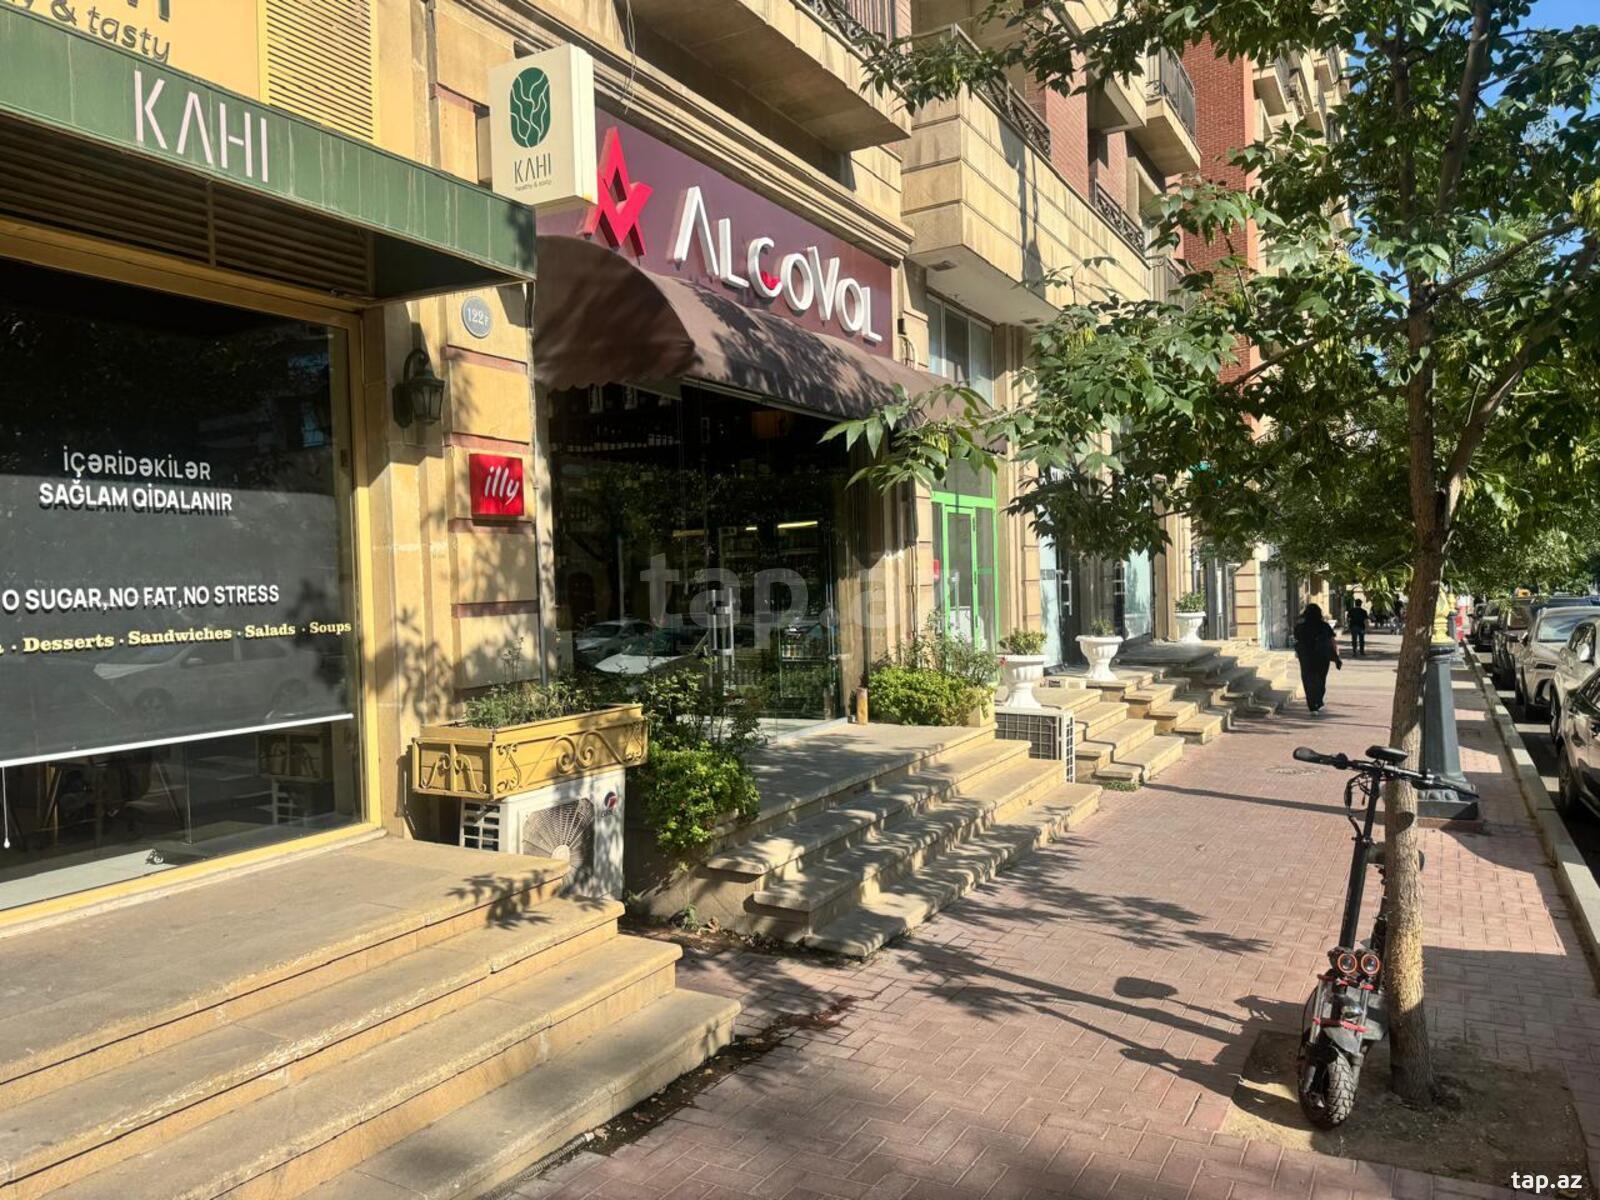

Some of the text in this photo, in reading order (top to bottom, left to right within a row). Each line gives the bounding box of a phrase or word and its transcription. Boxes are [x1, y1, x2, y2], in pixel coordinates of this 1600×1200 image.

[87, 6, 171, 64] tasty
[134, 71, 269, 183] KAHI
[514, 152, 552, 184] KAHI
[673, 186, 883, 343] ALCOVOL
[39, 479, 233, 511] SAĞLAM QİDALANIR
[484, 465, 519, 505] illy
[214, 584, 280, 604] STRESS
[23, 634, 115, 652] Desserts
[128, 627, 233, 645] Sandwiches
[244, 623, 296, 639] Salads
[309, 621, 352, 635] Soups
